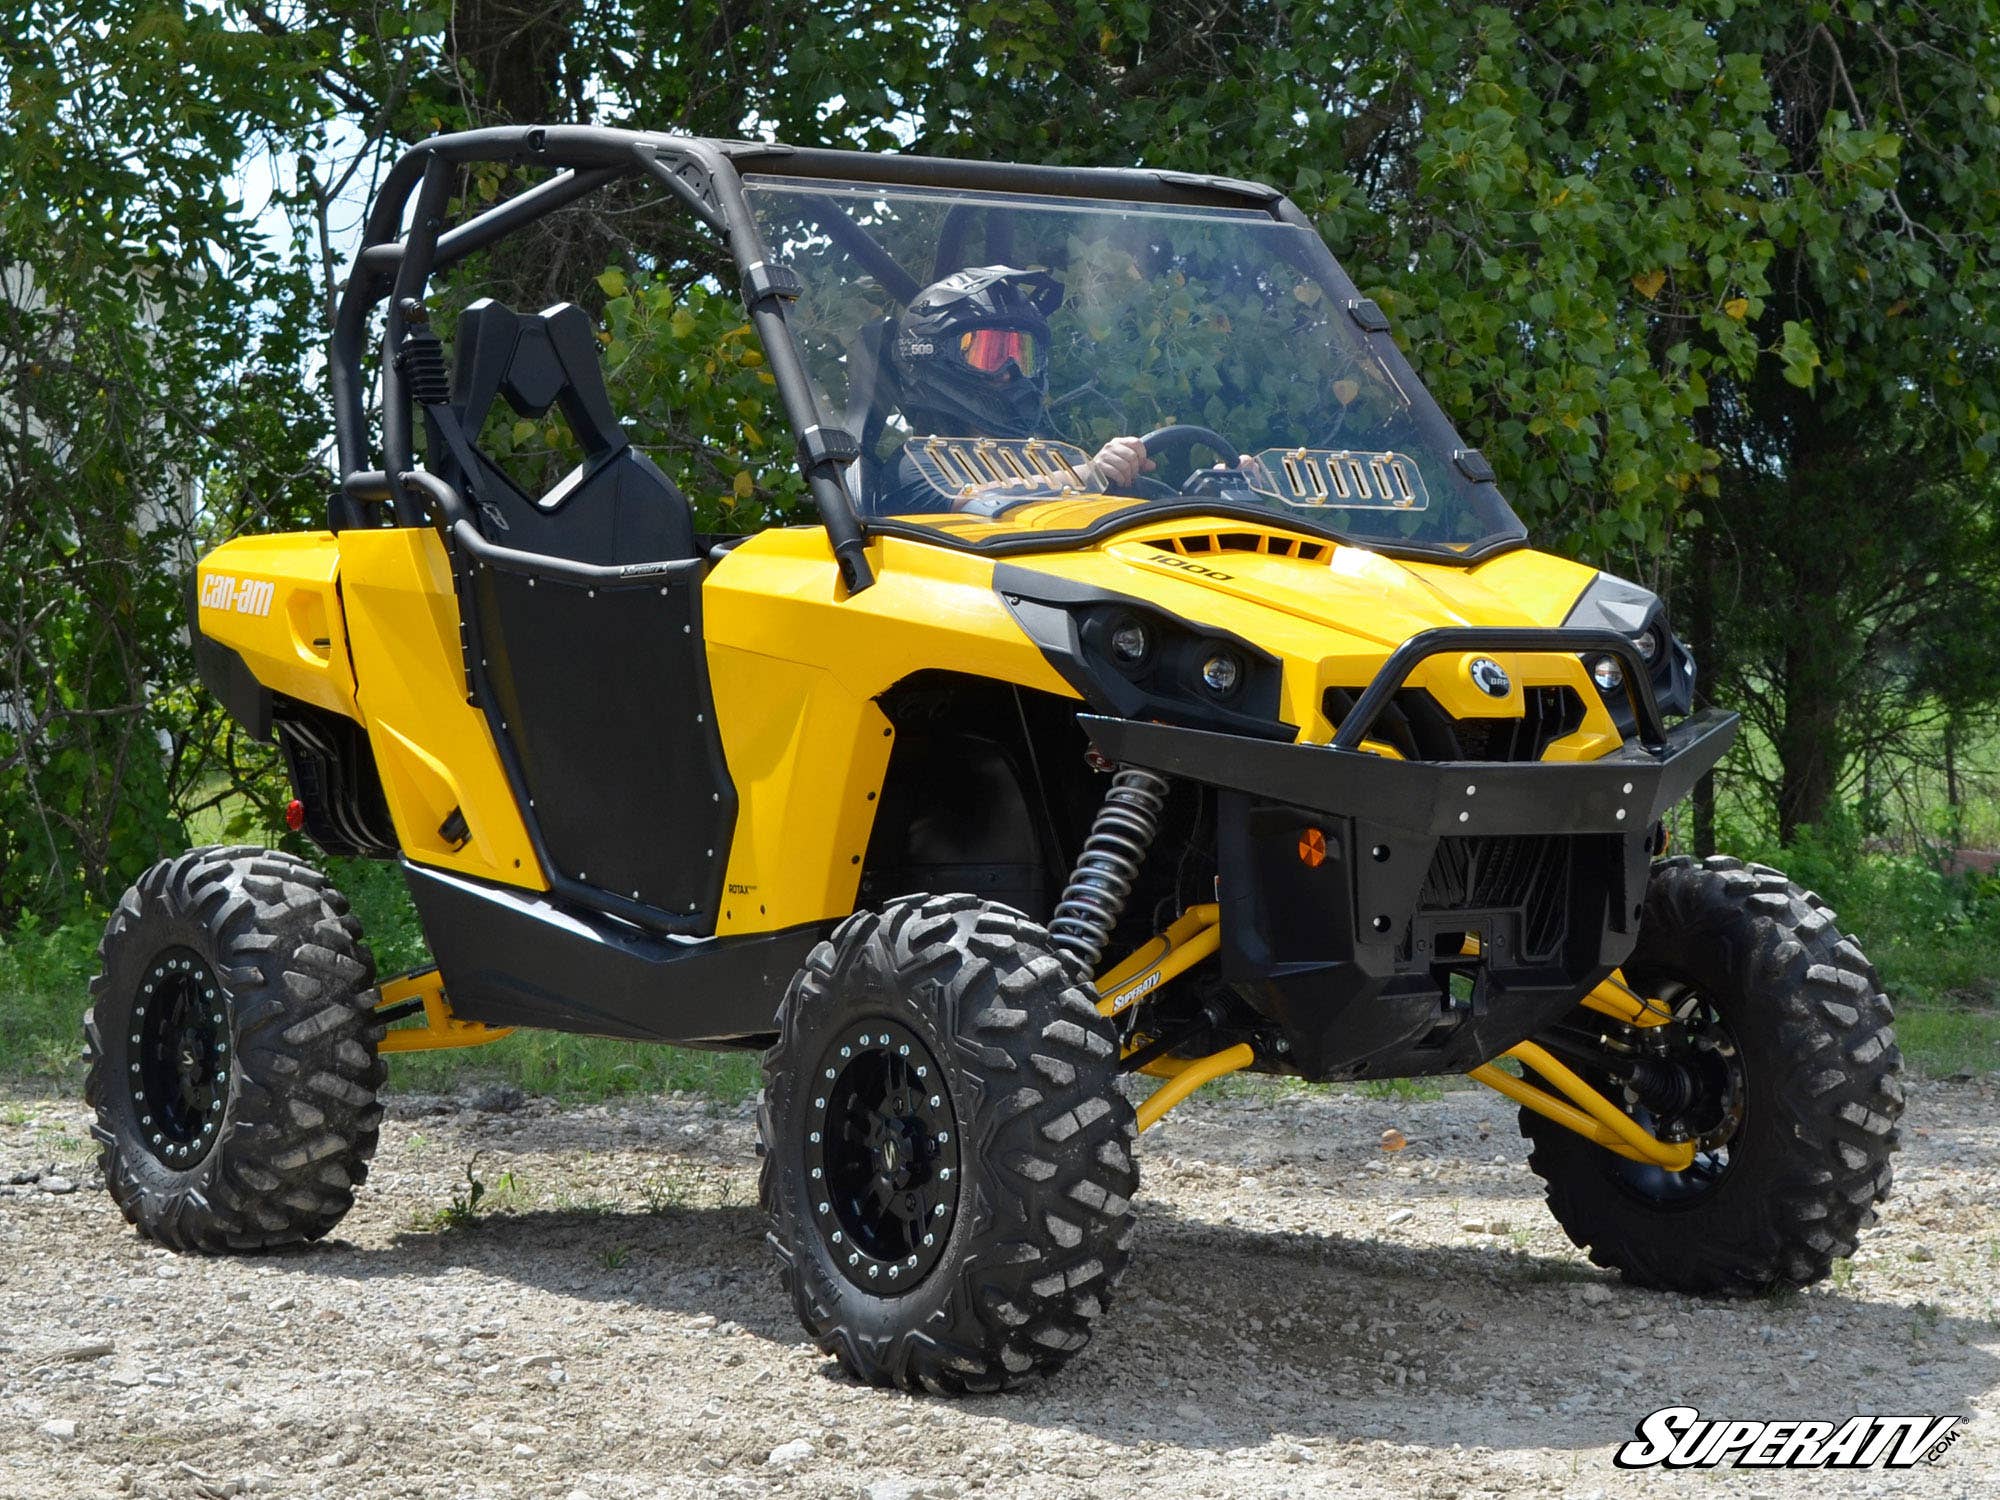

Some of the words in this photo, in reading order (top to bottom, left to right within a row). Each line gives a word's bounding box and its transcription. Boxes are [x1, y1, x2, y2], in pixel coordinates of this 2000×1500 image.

[1147, 554, 1235, 581] 1000
[201, 573, 275, 617] can-am
[728, 883, 749, 895] ROTAX
[1113, 970, 1161, 1013] SUPERATV
